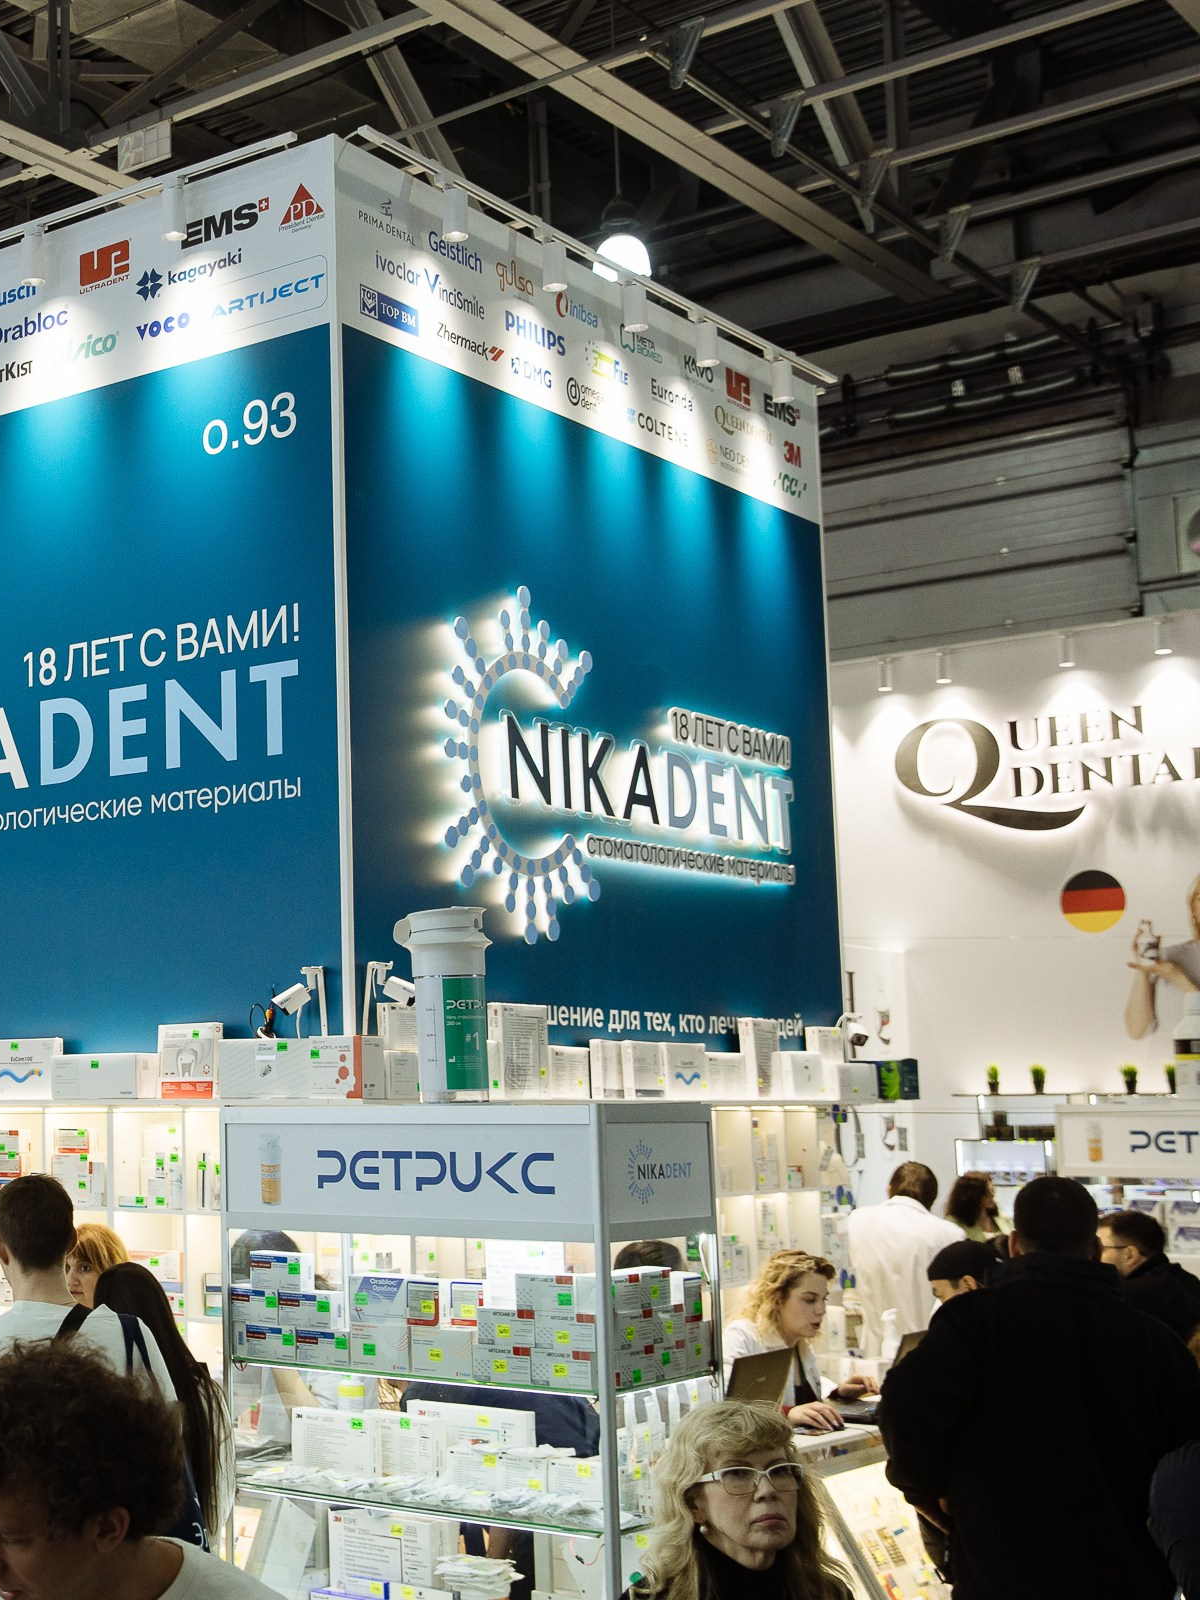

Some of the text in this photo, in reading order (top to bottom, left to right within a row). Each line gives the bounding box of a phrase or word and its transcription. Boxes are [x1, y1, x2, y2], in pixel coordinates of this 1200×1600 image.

[181, 202, 259, 250] EMS
[278, 213, 325, 232] President Dental
[358, 209, 416, 247] PRIMA DENTAL
[167, 247, 242, 285] kagayaki
[375, 250, 420, 287] ivoclar
[428, 231, 482, 274] Geistlich
[80, 274, 130, 295] ULTRADENT
[210, 273, 326, 319] ARTIJECT
[424, 267, 485, 320] VinciSmile
[380, 301, 416, 328] TOP BM
[570, 300, 598, 328] inibsa
[437, 322, 488, 361] Zhermack
[505, 310, 566, 357] PHILIPS
[636, 333, 655, 352] META
[524, 361, 552, 389] DMG
[763, 393, 796, 428] EMS
[783, 440, 802, 468] 3M
[23, 602, 300, 687] 18 ЛЕТ С ВАМИ!
[672, 710, 791, 767] 18 ЛЕТ С ВАМИ!
[503, 714, 793, 855] NIKADENT
[895, 705, 1144, 831] QUEEN
[150, 776, 302, 816] материалы
[586, 834, 796, 885] стоматологические материалы
[608, 1010, 641, 1034] для
[643, 1011, 676, 1037] тех,
[679, 1014, 704, 1034] кто
[637, 1161, 692, 1181] NIKADENT
[369, 1278, 397, 1286] Orabloc
[332, 1515, 358, 1526] 3M ESPE
